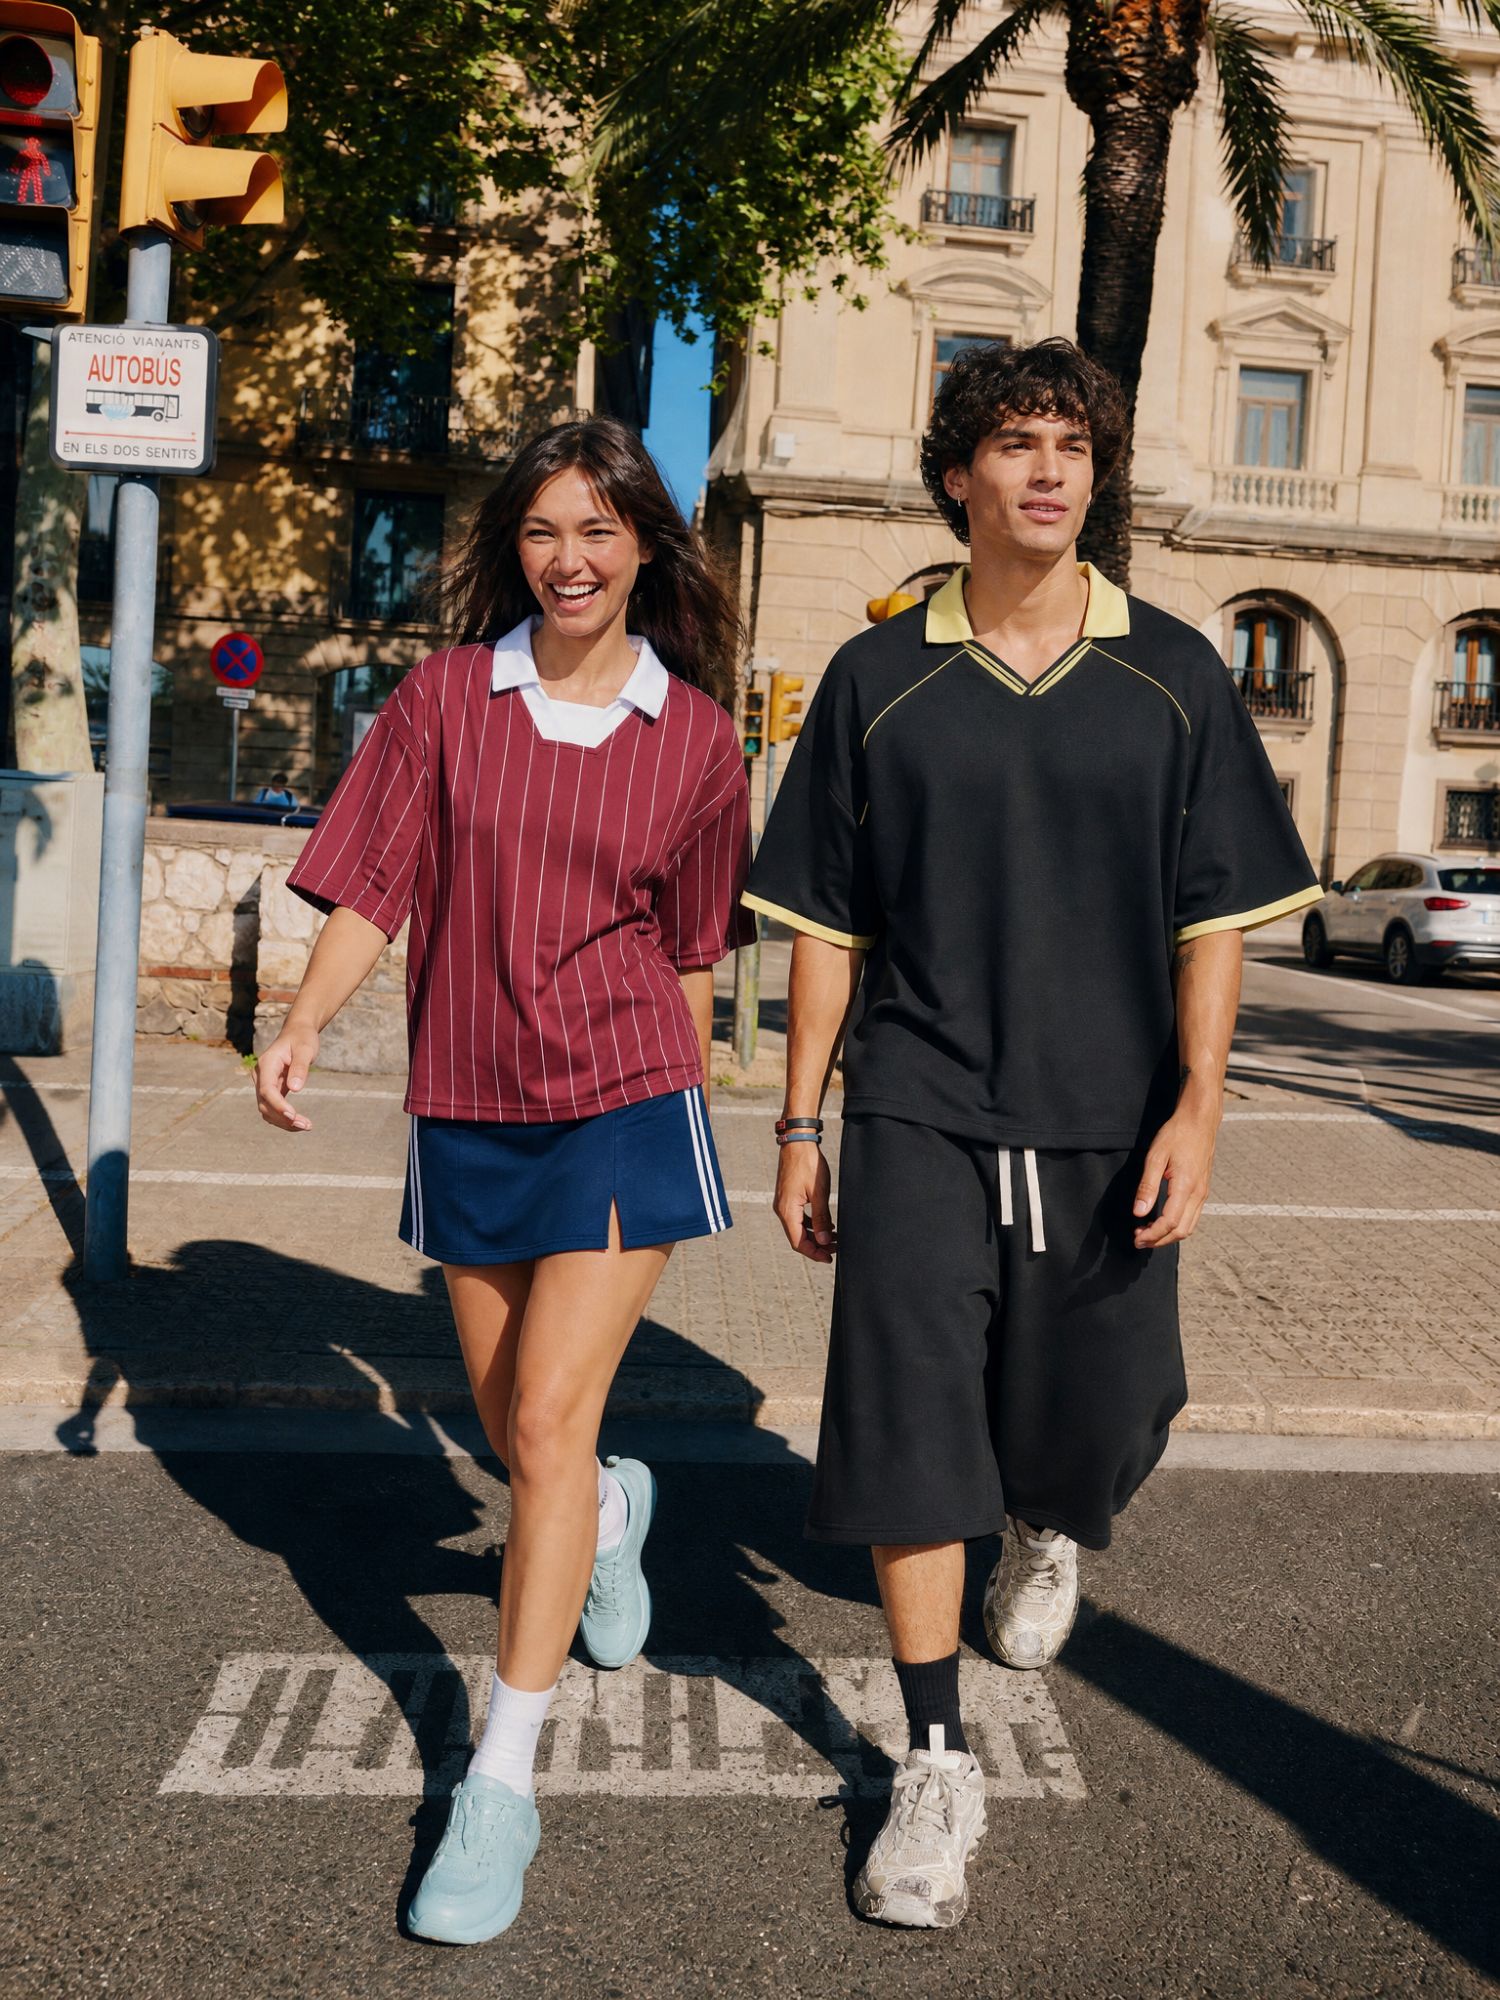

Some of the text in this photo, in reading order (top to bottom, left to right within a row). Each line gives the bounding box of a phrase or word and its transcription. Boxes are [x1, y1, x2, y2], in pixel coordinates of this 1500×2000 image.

[67, 332, 200, 350] ATENCIÓ VIANANTS
[87, 351, 182, 387] AUTOBÚS
[63, 442, 197, 460] EN ELS DOS SENTITS
